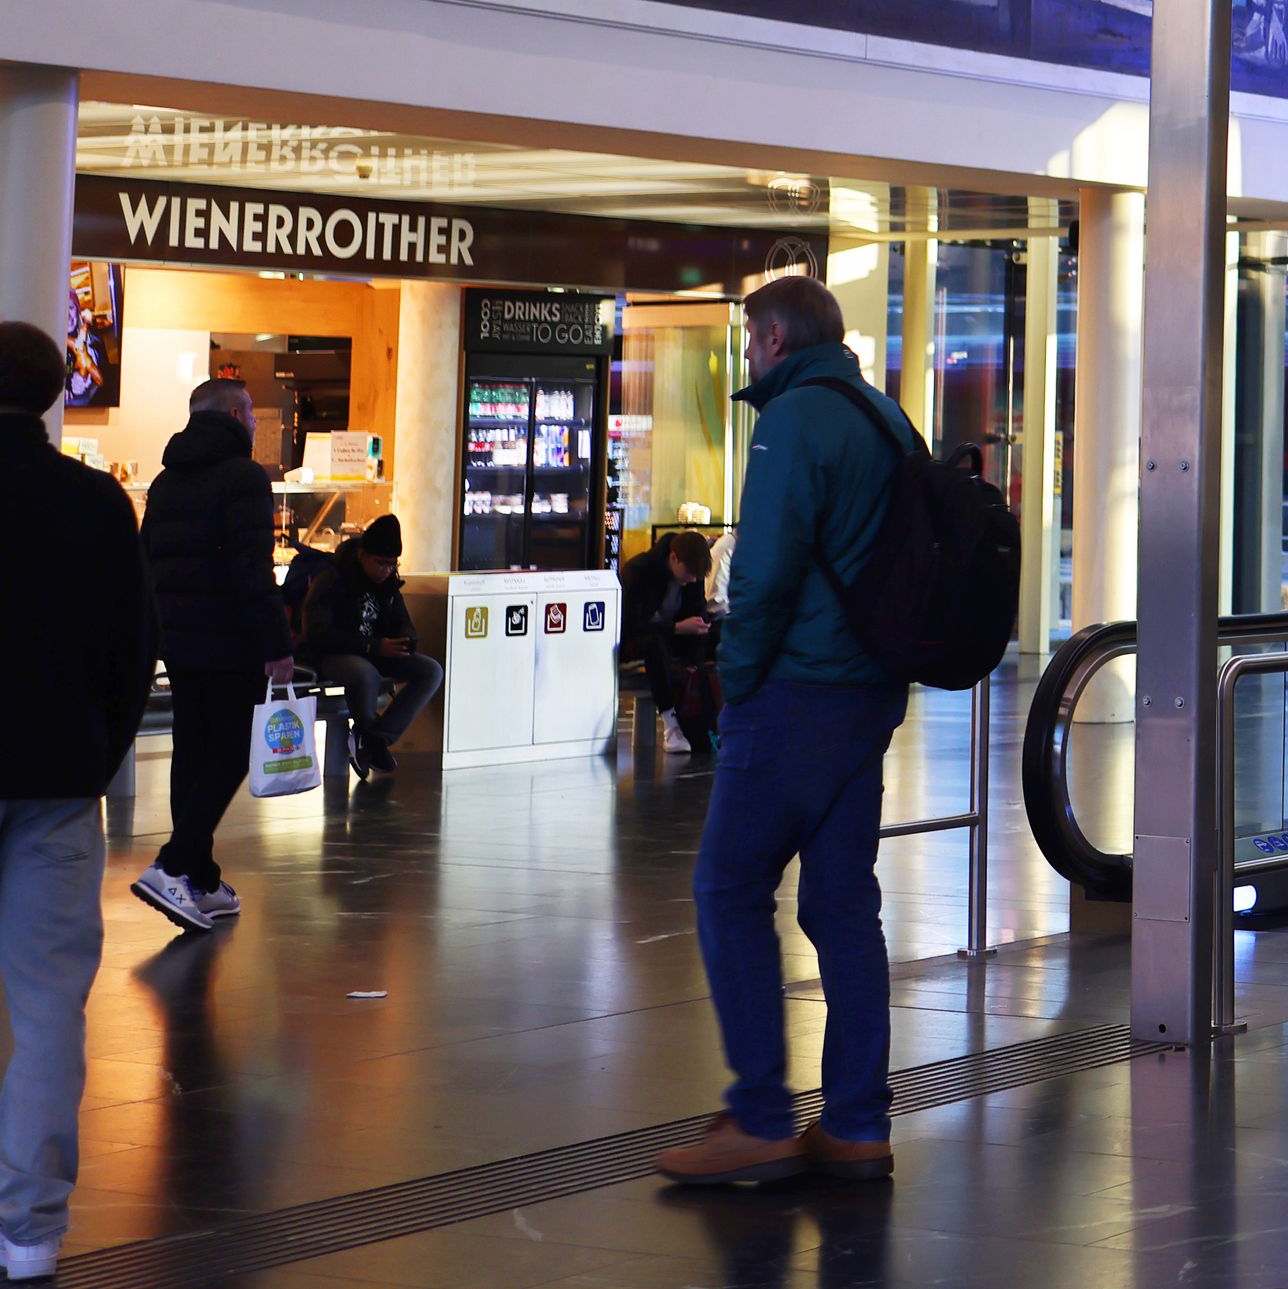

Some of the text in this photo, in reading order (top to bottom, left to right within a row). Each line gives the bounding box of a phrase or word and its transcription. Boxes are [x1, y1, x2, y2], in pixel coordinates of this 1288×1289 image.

[117, 191, 475, 267] WIENERROITHER
[480, 298, 491, 340] COOL
[504, 300, 561, 322] DRINKS
[531, 323, 583, 344] TO GO
